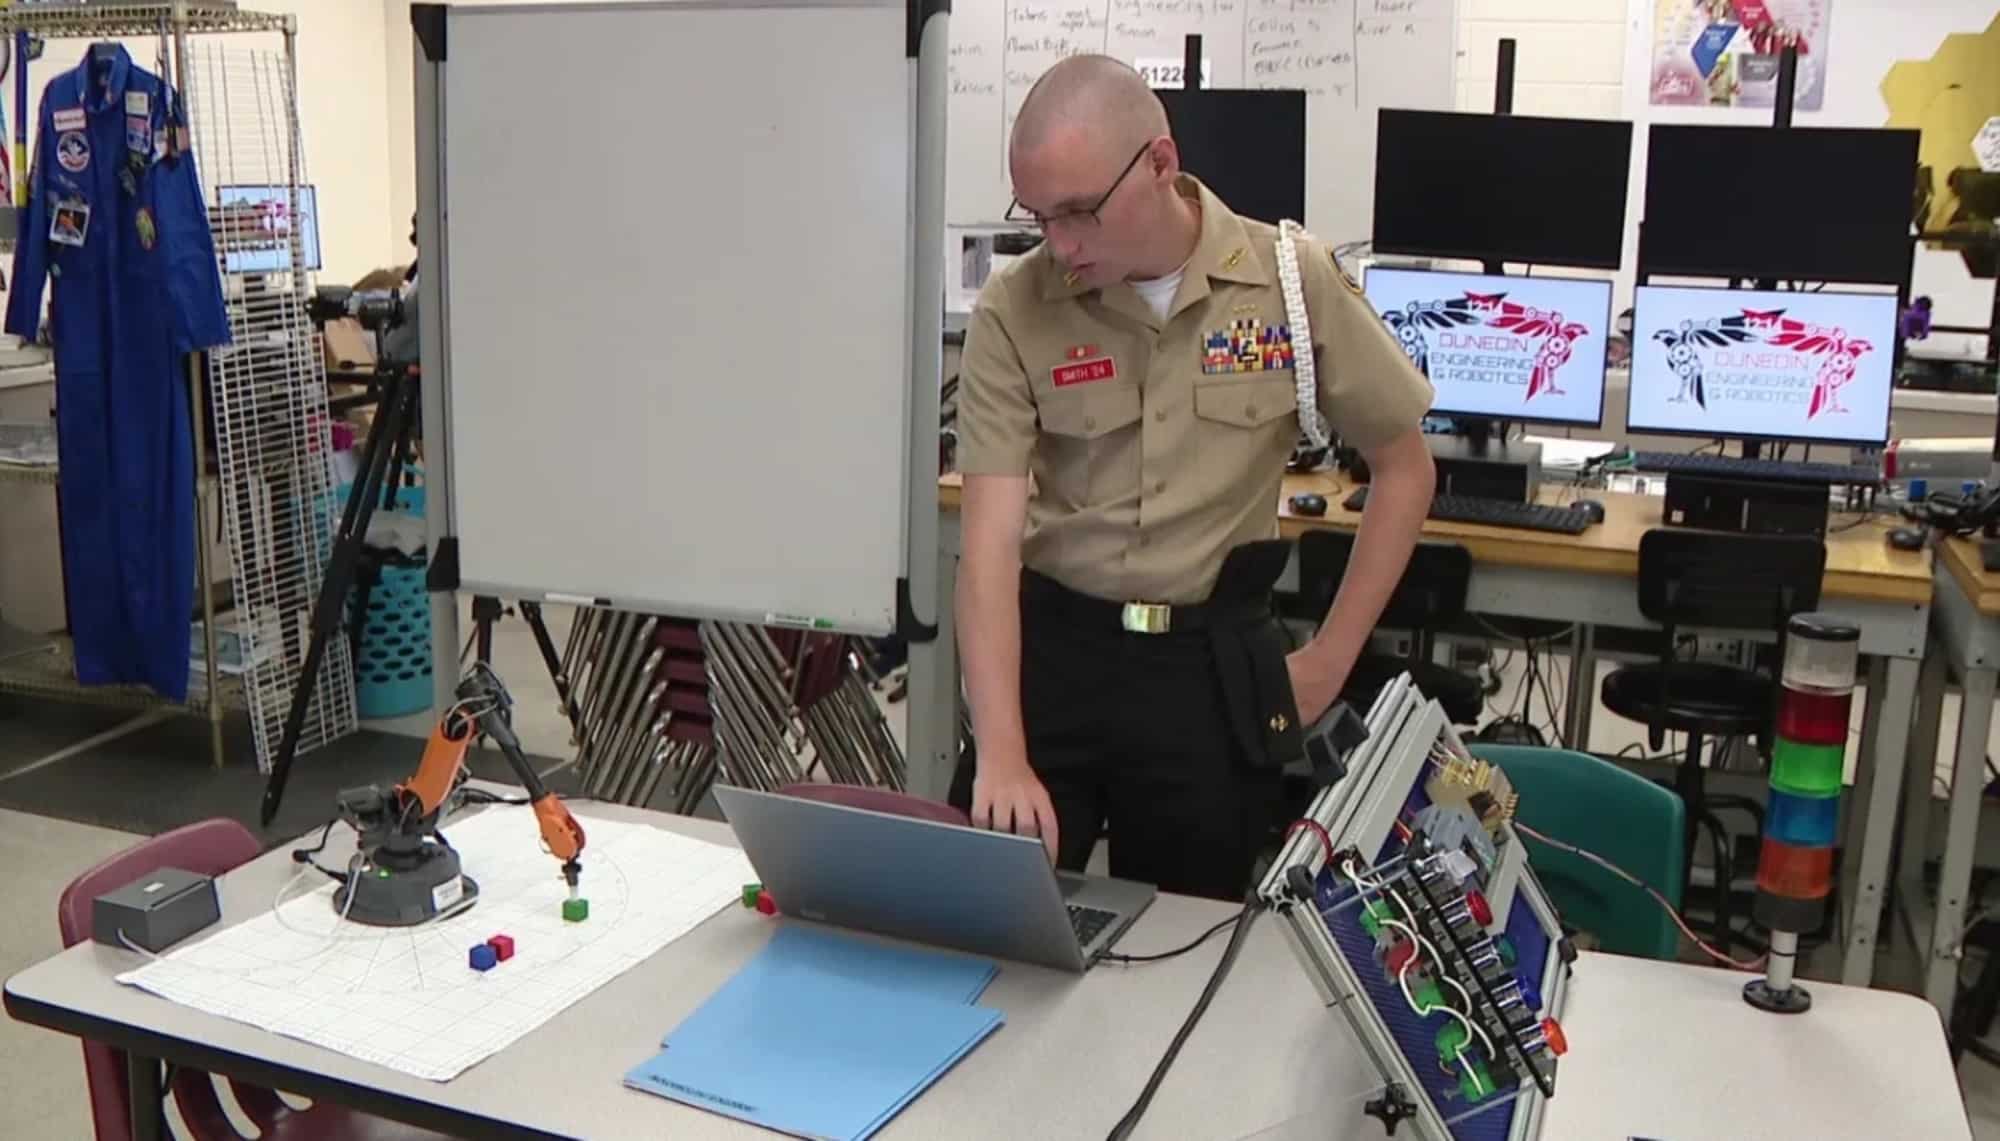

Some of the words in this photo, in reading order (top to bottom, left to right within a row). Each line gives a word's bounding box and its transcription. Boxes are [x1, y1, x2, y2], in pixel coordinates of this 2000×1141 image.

[1140, 66, 1205, 82] 5122
[1439, 332, 1528, 352] DUNEDIN
[1431, 352, 1534, 369] ENGINEERING
[1714, 351, 1808, 369] DUNEDIN
[1448, 368, 1529, 385] ROBOTICS
